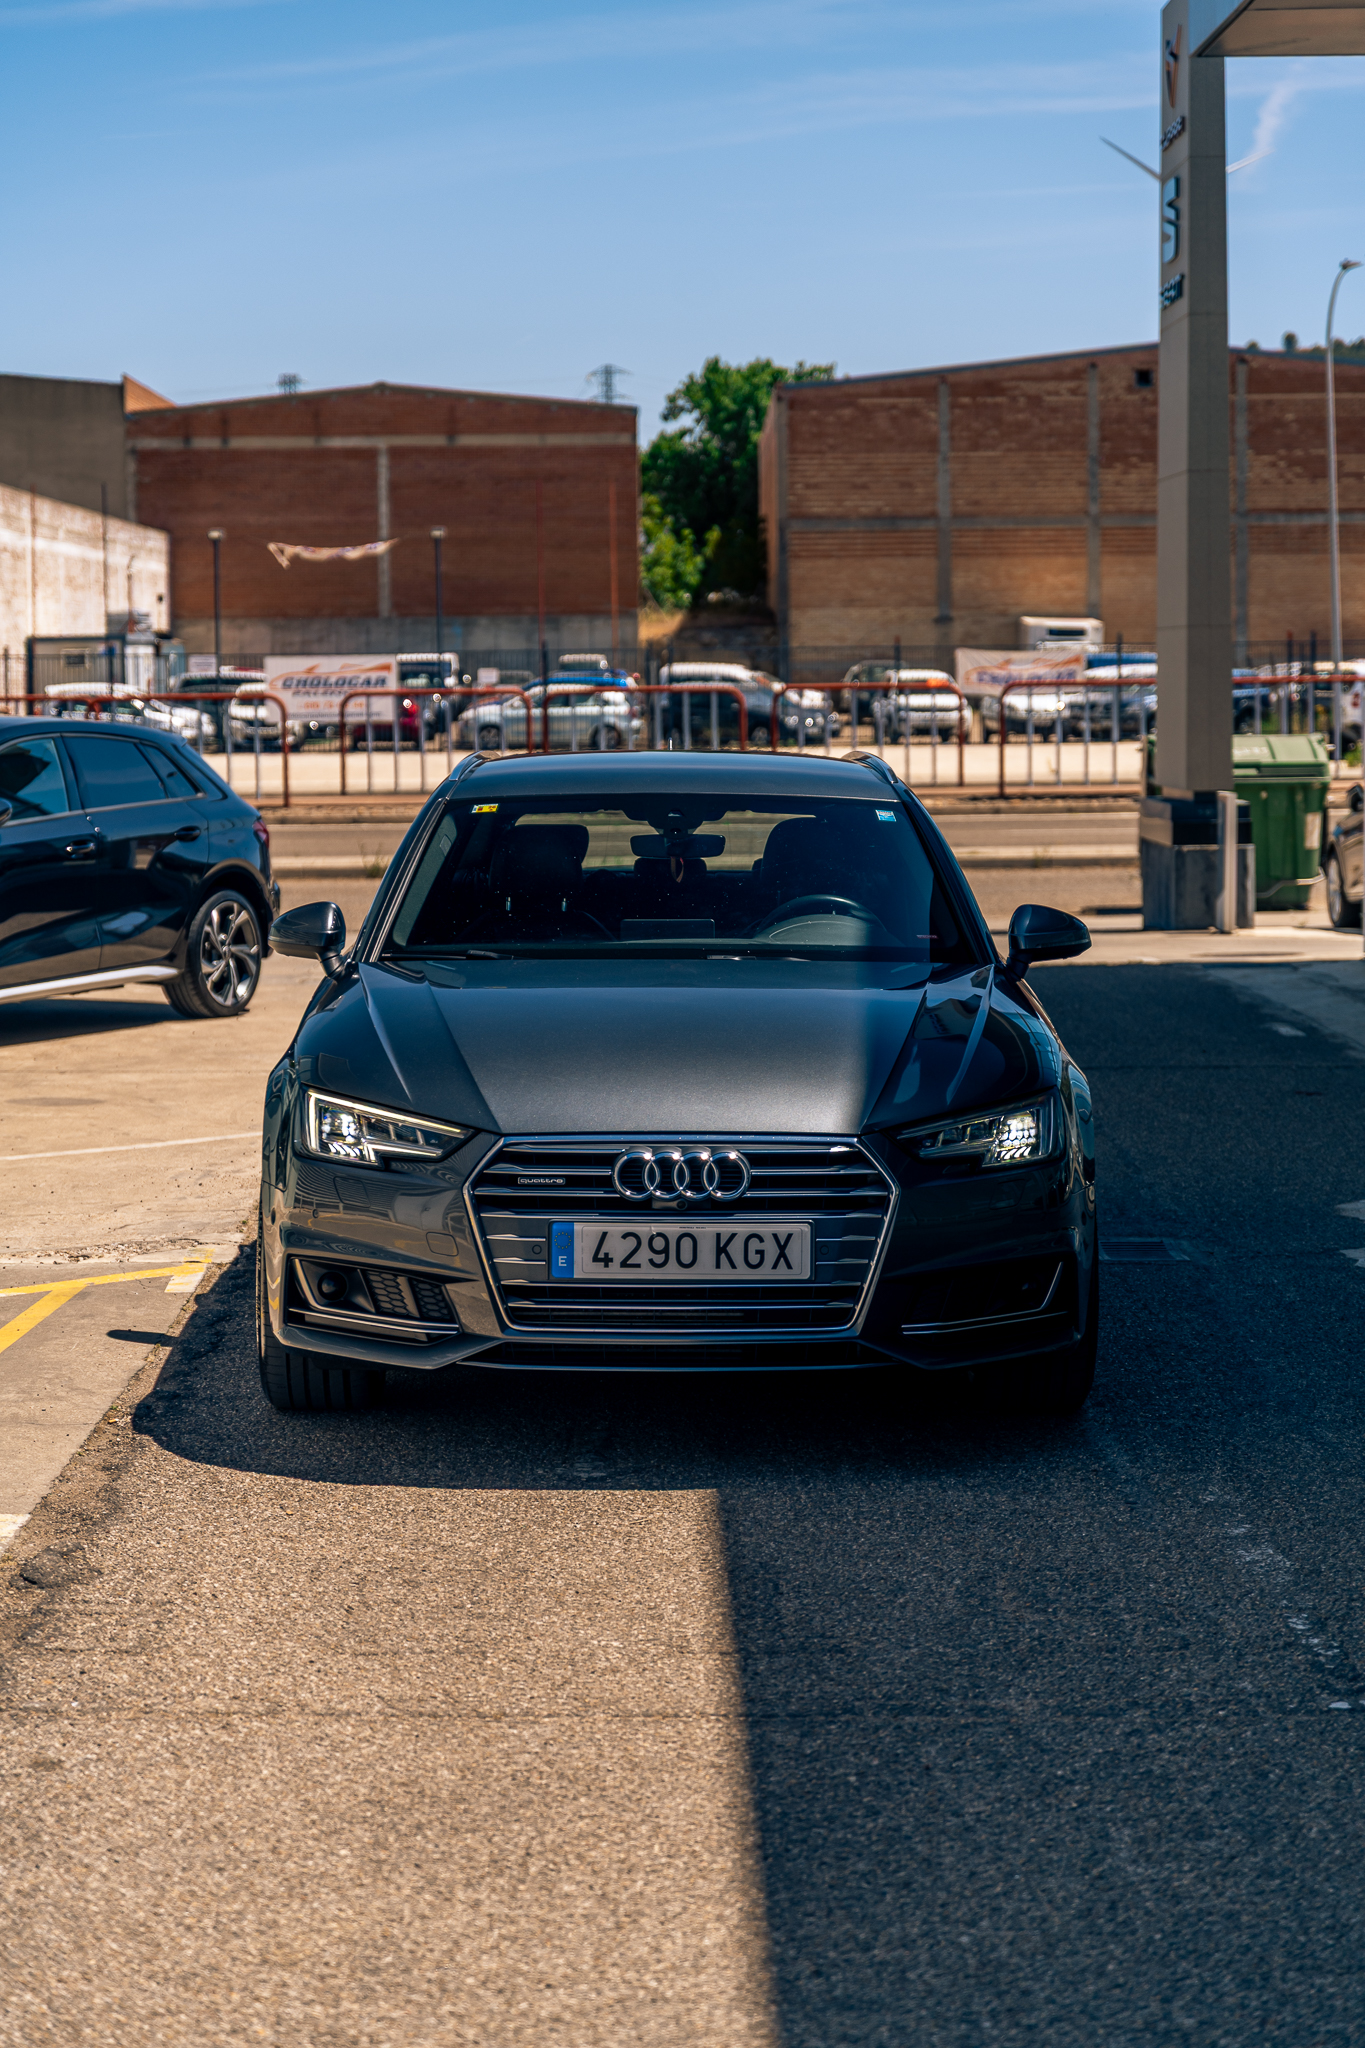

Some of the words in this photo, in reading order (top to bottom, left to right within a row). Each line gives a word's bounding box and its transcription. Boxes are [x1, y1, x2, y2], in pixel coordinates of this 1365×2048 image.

[558, 1256, 567, 1267] E
[592, 1231, 698, 1269] 4290
[715, 1233, 794, 1270] KGX
